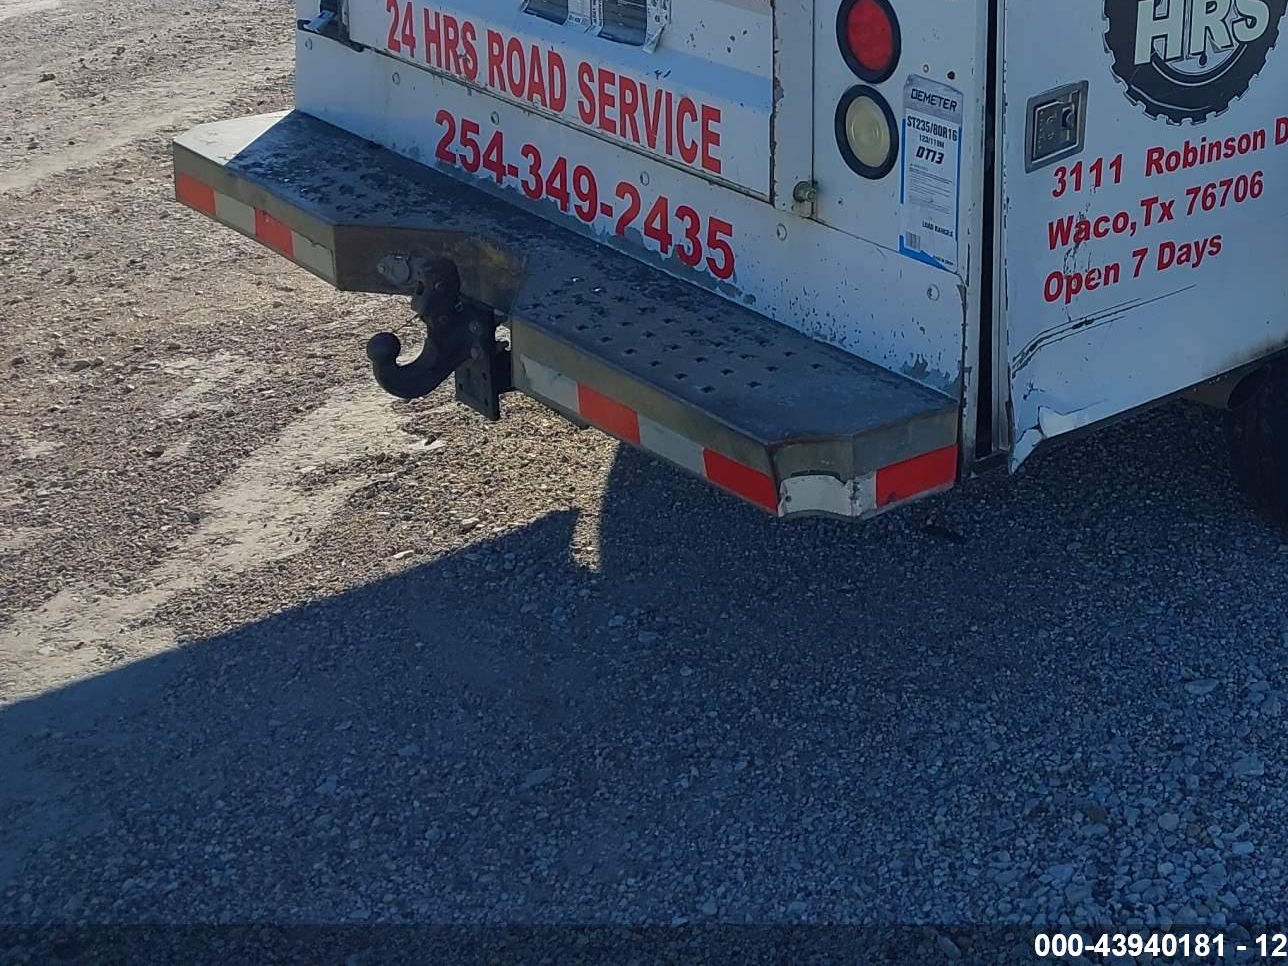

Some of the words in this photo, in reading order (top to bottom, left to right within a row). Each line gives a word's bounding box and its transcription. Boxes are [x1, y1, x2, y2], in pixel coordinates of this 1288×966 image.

[423, 7, 478, 83] HRS
[486, 29, 567, 113] ROAD
[577, 61, 722, 175] SERVICE
[911, 88, 958, 113] DEMETER
[906, 115, 958, 142] ST235/80R16
[1052, 153, 1123, 198] 3111
[1144, 128, 1266, 177] Robinson
[434, 109, 736, 280] 254-349-2435
[1185, 170, 1264, 216] 76706
[1044, 261, 1120, 305] Open
[1132, 247, 1148, 278] 7
[1156, 234, 1223, 271] Days
